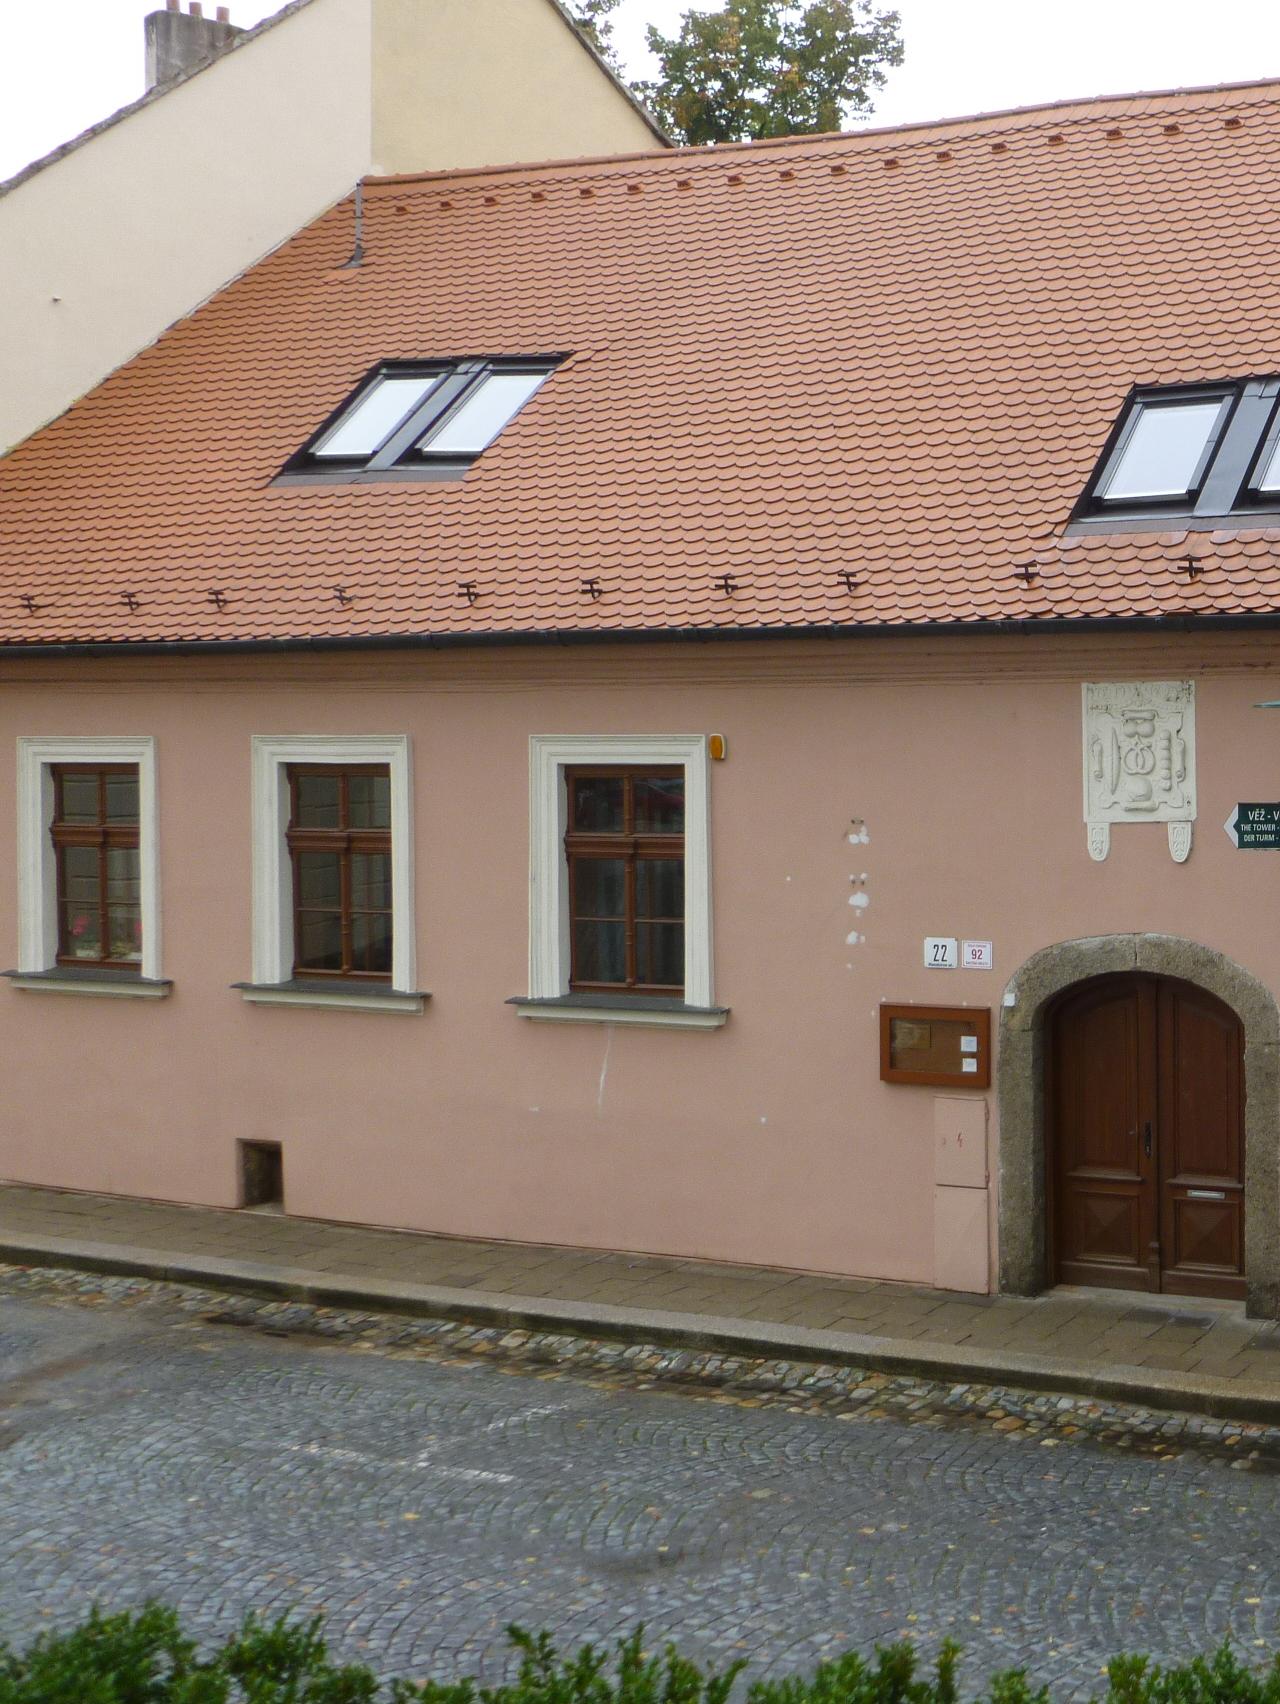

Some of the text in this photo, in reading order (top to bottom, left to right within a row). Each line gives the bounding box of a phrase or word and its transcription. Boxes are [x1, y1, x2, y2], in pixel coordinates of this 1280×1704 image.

[1248, 809, 1265, 820] VĚŽ
[1244, 834, 1255, 842] DER
[934, 944, 948, 962] 22
[971, 949, 983, 960] 92
